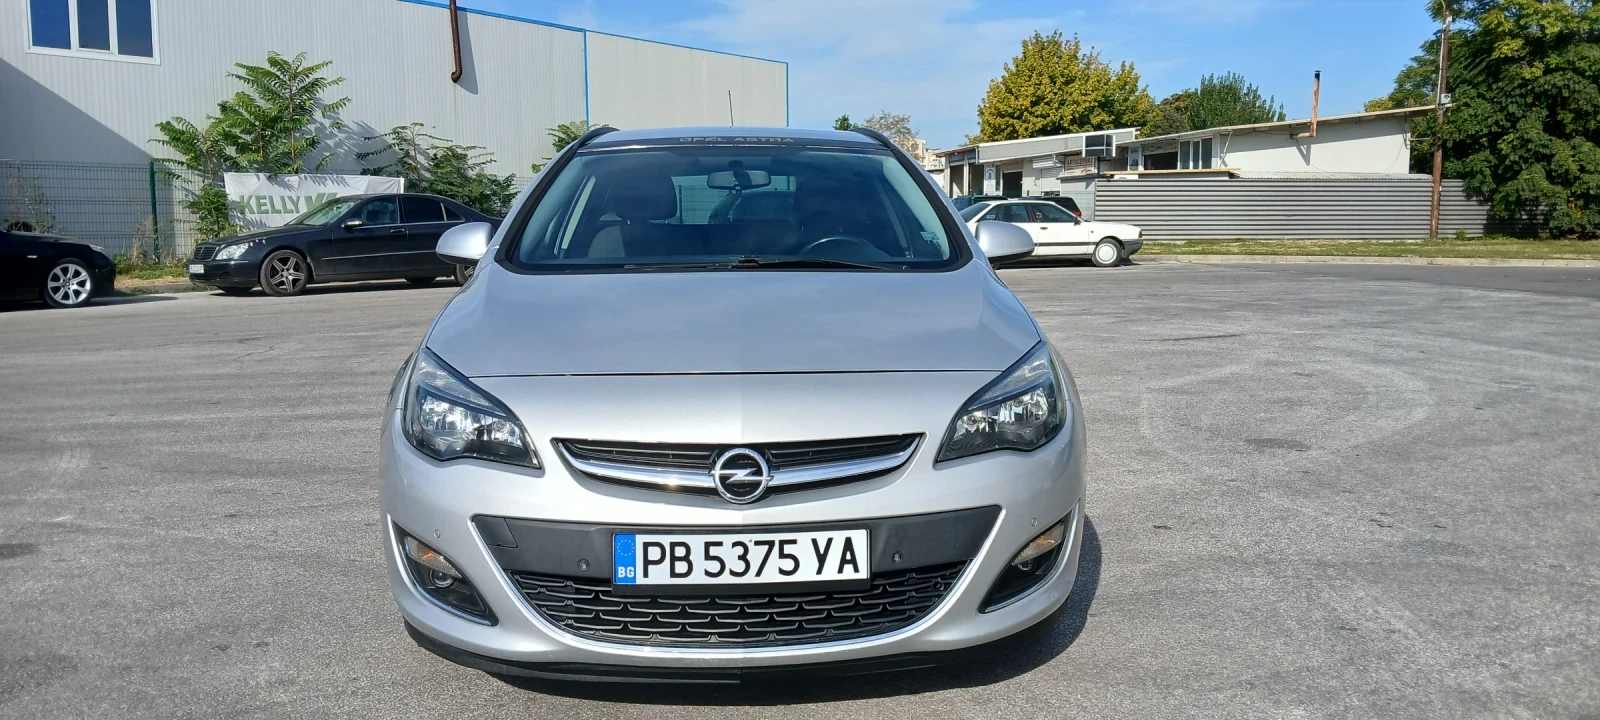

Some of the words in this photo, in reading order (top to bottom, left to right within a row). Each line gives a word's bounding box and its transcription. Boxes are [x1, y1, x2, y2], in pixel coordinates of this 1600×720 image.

[239, 195, 301, 214] KELLY
[642, 541, 694, 579] PB
[703, 539, 801, 578] 5375
[810, 536, 860, 576] YA
[617, 566, 635, 578] BG
